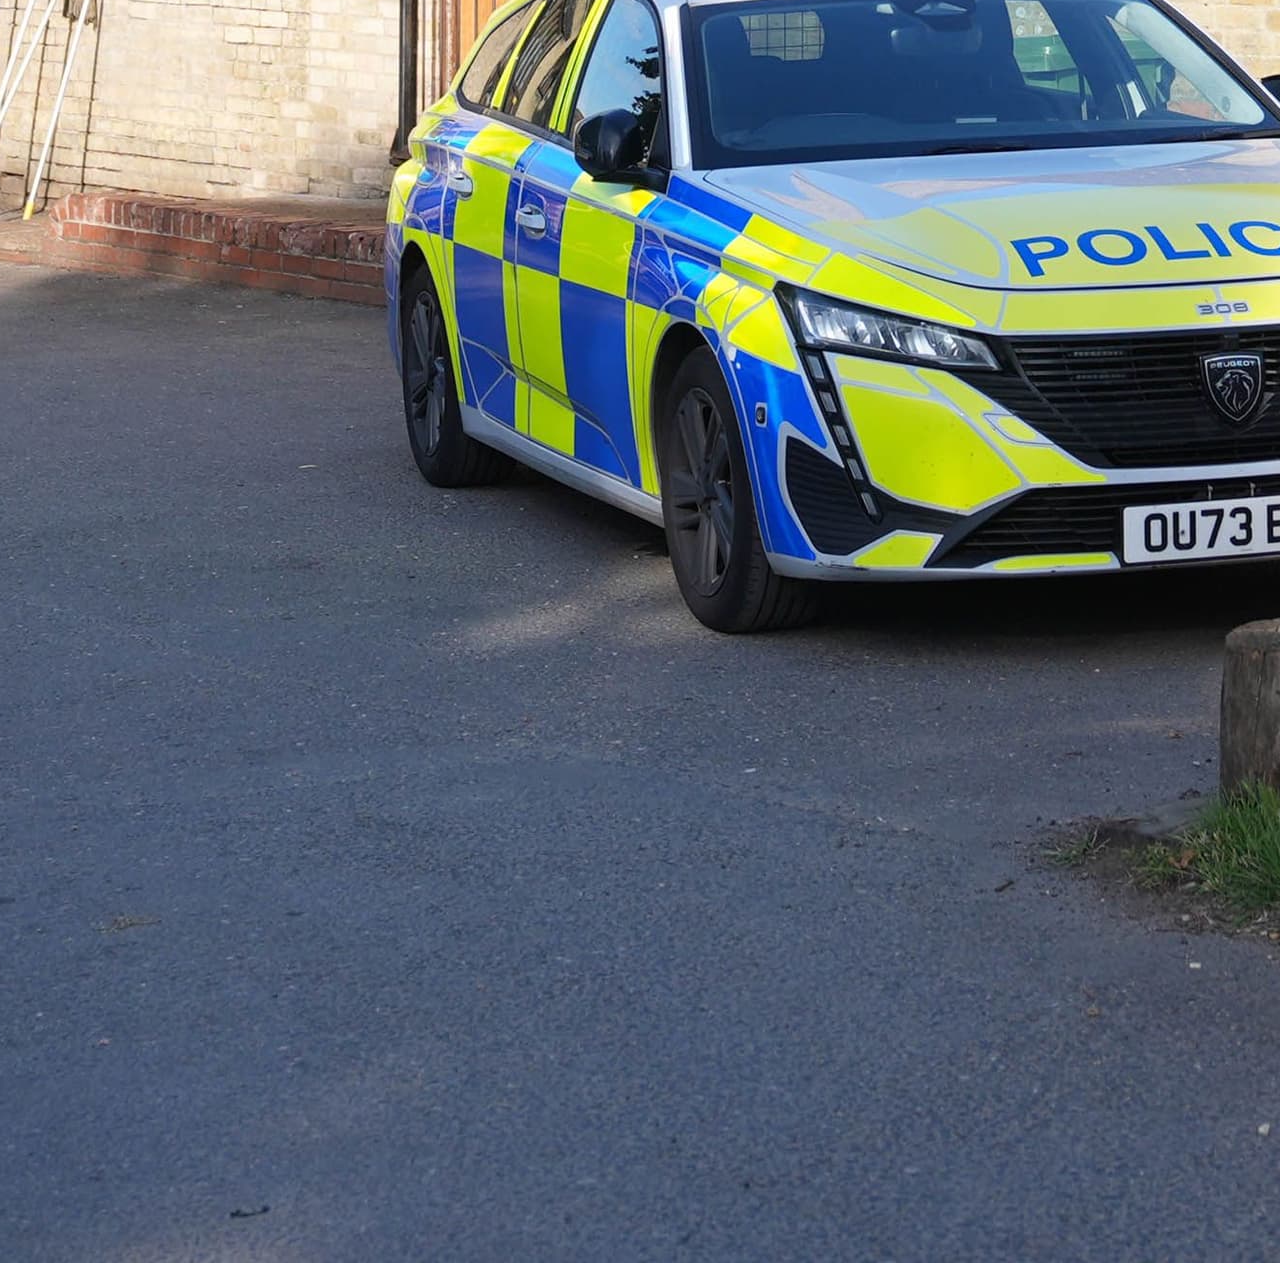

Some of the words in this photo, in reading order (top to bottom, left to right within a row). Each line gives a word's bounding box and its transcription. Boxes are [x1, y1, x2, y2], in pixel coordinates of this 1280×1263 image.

[1197, 302, 1249, 315] 308
[1210, 360, 1256, 369] PEUGEOT
[1144, 508, 1253, 553] OU73
